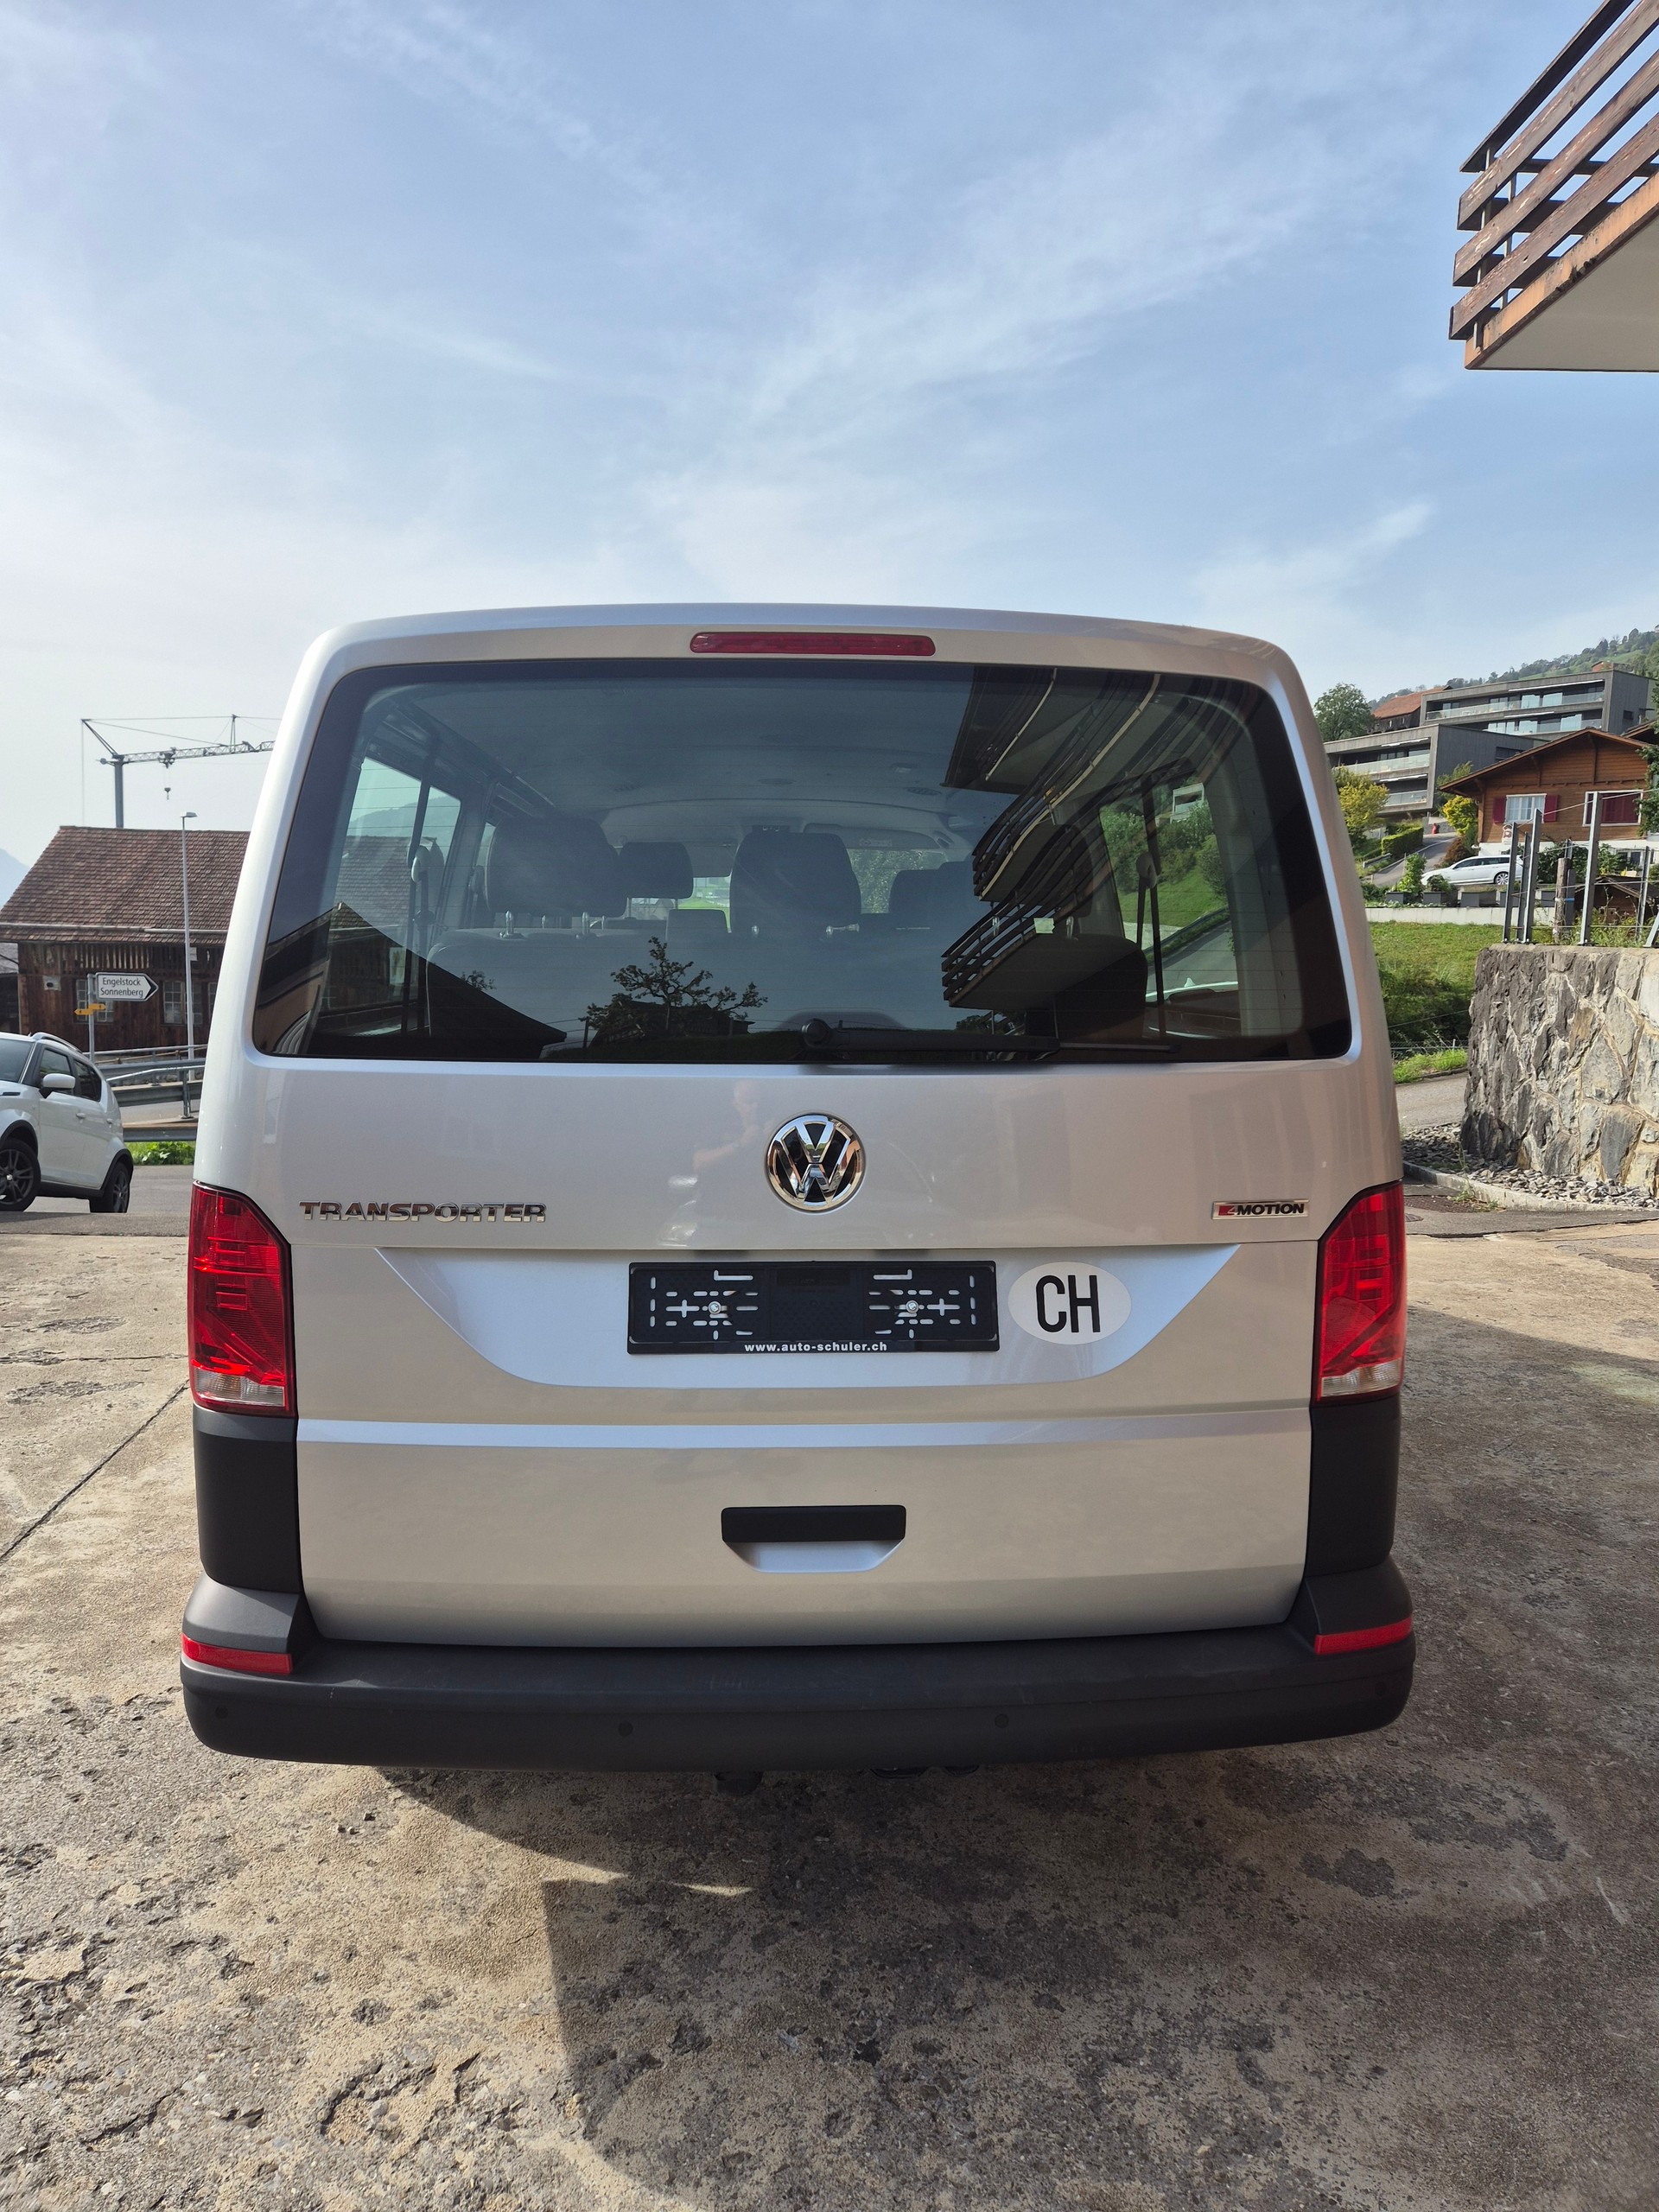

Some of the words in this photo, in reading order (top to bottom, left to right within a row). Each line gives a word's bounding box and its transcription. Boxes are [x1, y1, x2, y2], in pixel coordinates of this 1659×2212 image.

[102, 977, 141, 988] Engelstock
[100, 988, 143, 997] Sonnenberg
[767, 1114, 865, 1211] VW
[299, 1201, 547, 1223] TRANSPORTER
[1036, 1274, 1101, 1332] CH
[744, 1342, 887, 1351] www.auto-schuler.ch
